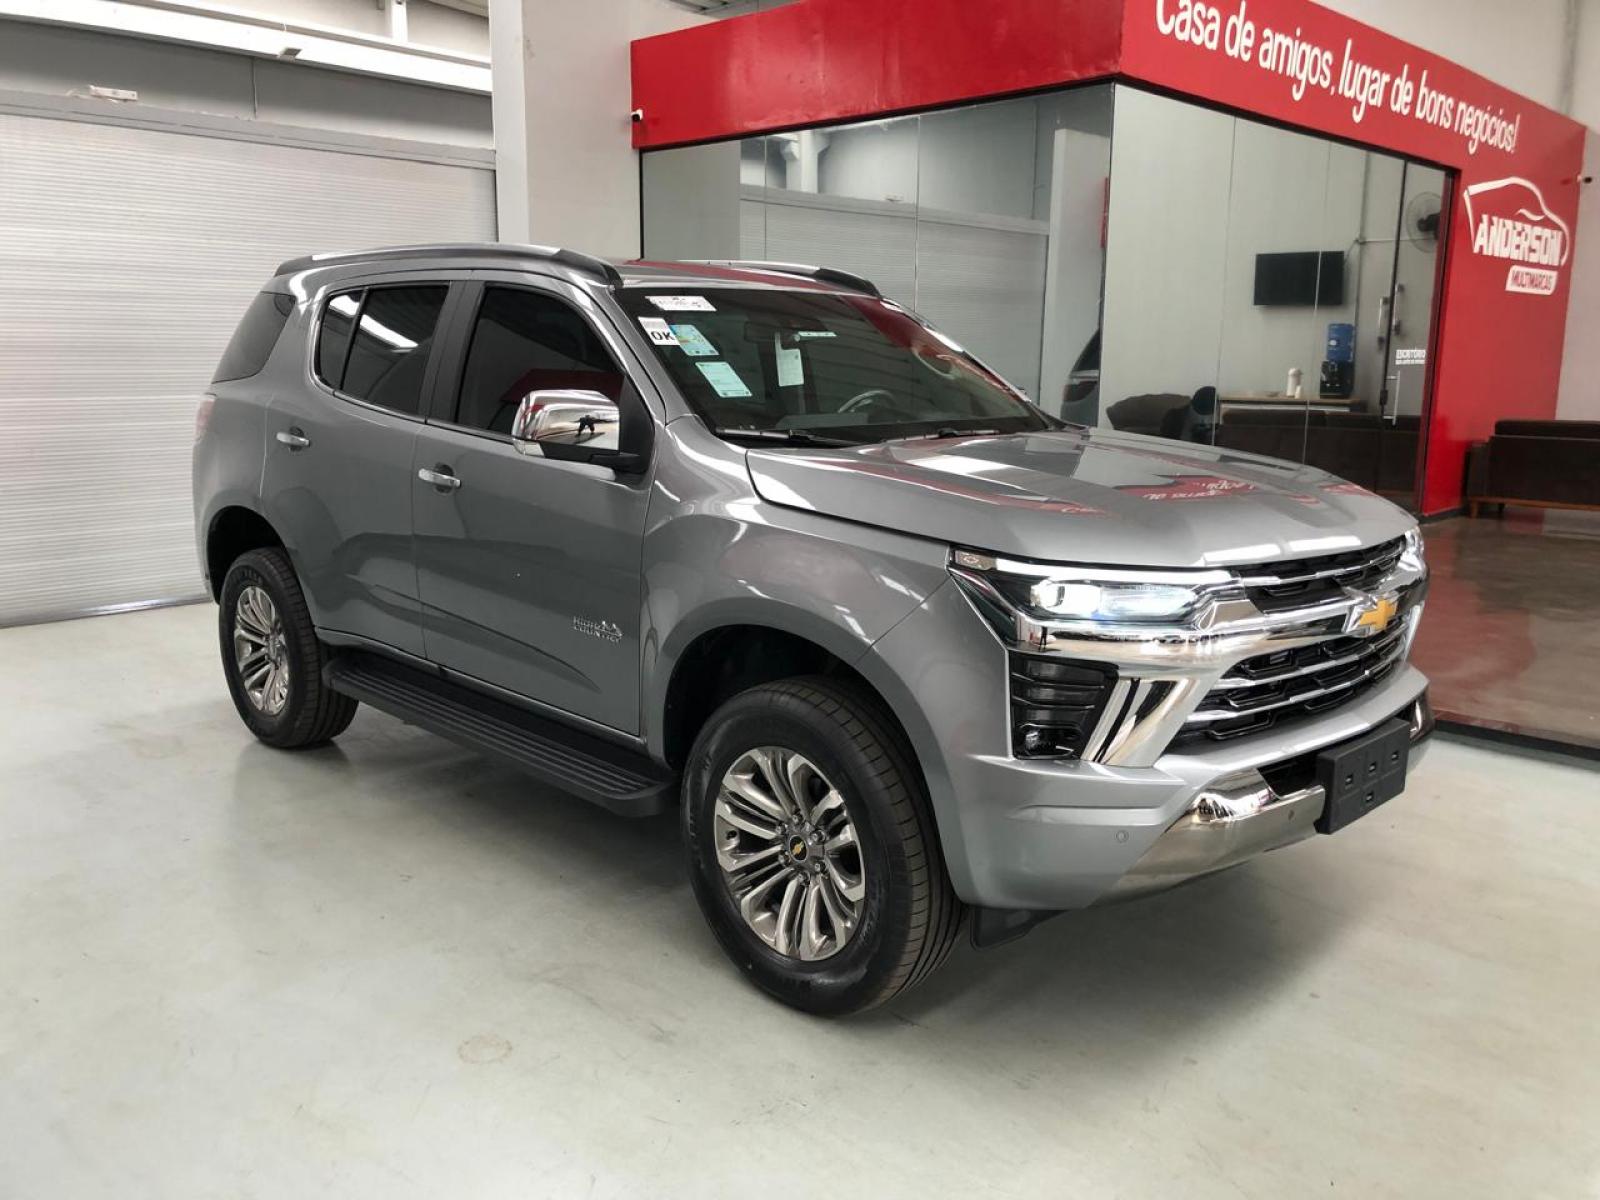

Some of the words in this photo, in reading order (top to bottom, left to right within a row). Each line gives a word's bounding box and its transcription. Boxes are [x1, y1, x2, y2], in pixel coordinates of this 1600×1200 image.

[1156, 0, 1220, 50] Casa
[1225, 0, 1255, 62] de
[1258, 27, 1335, 101] amigos,
[1338, 39, 1391, 123] lugar
[1390, 64, 1413, 115] de
[1415, 70, 1454, 129] bons
[1454, 102, 1521, 154] negócios!
[1473, 214, 1562, 266] ANDERSON
[651, 330, 676, 341] OK
